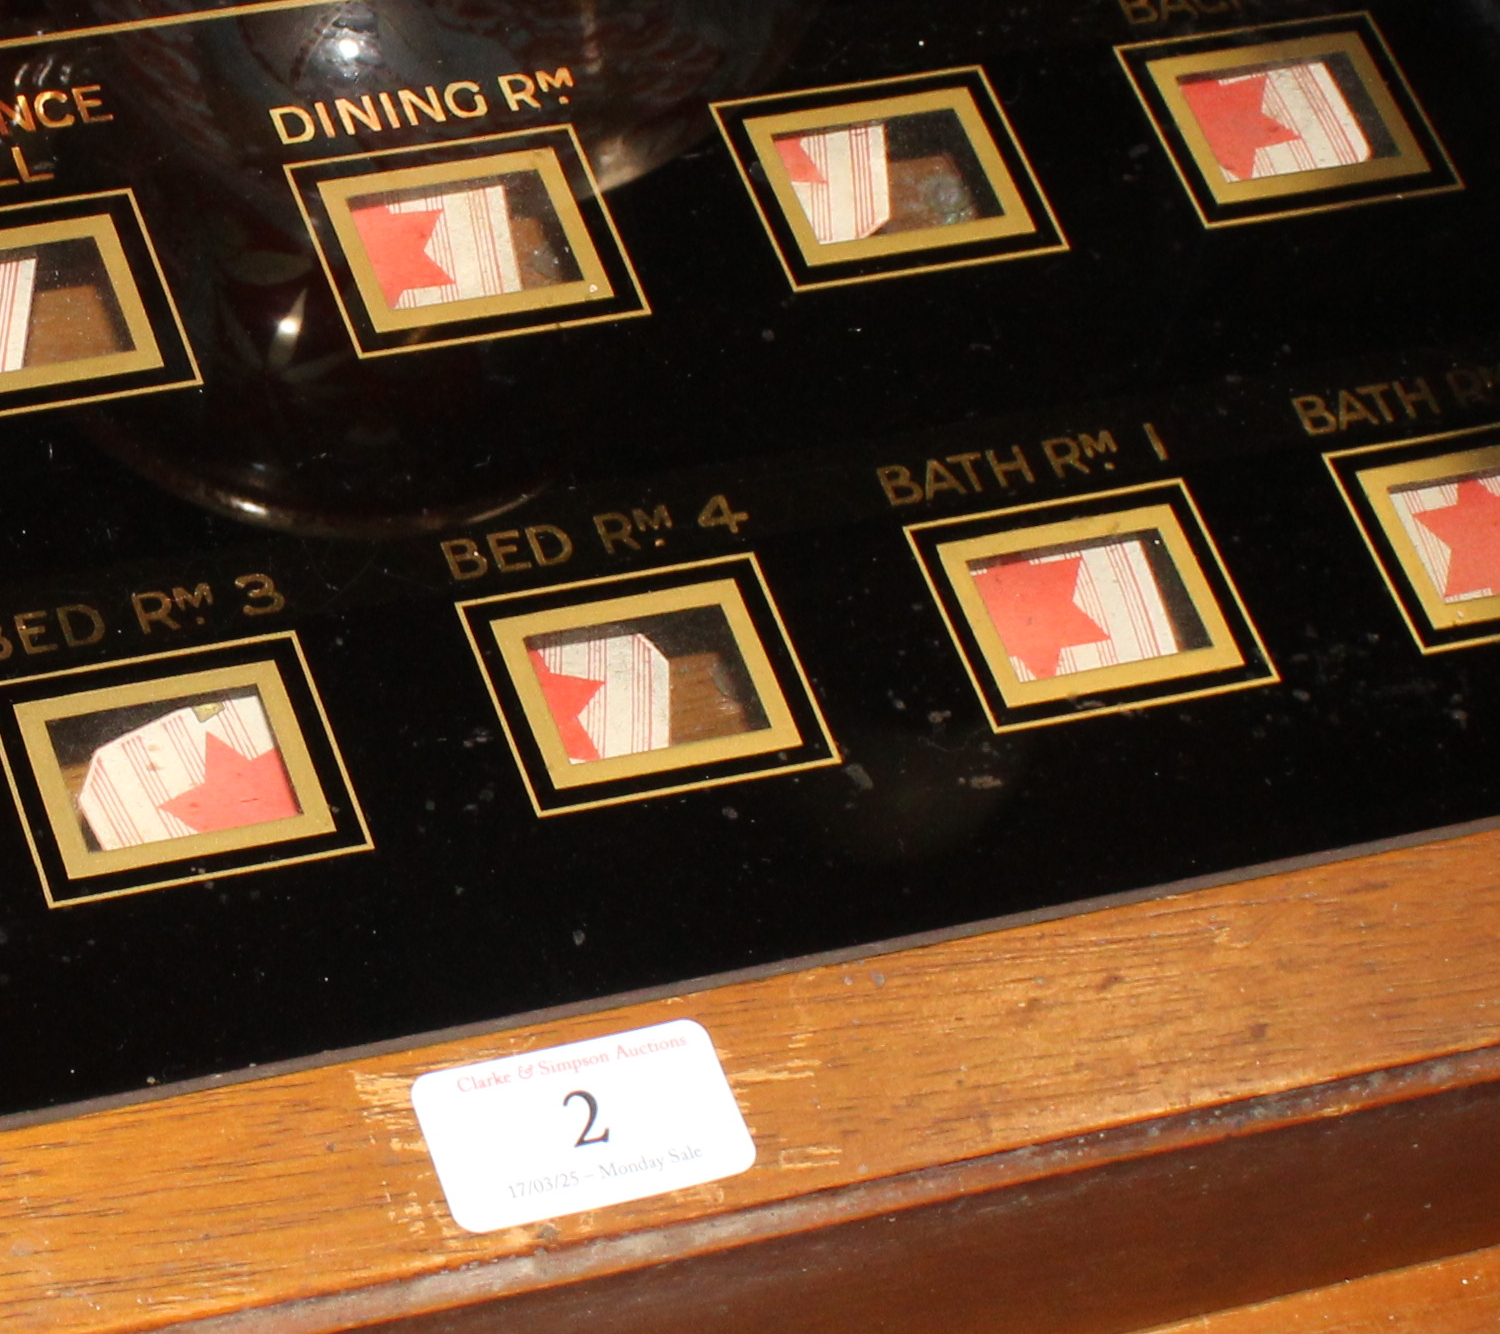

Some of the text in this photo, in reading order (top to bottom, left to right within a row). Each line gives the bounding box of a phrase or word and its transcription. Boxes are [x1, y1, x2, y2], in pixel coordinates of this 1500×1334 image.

[269, 80, 489, 147] DINING
[1290, 377, 1442, 436] BATH
[876, 444, 1033, 506] BATH
[440, 523, 574, 581] BED
[696, 493, 749, 535] 4
[234, 572, 286, 617] 3
[456, 1033, 688, 1094] Clarke & Simpson Auctions
[562, 1089, 610, 1148] 2
[507, 1170, 580, 1200] 17/03/25
[598, 1153, 665, 1180] Monday
[668, 1144, 703, 1164] Sale
